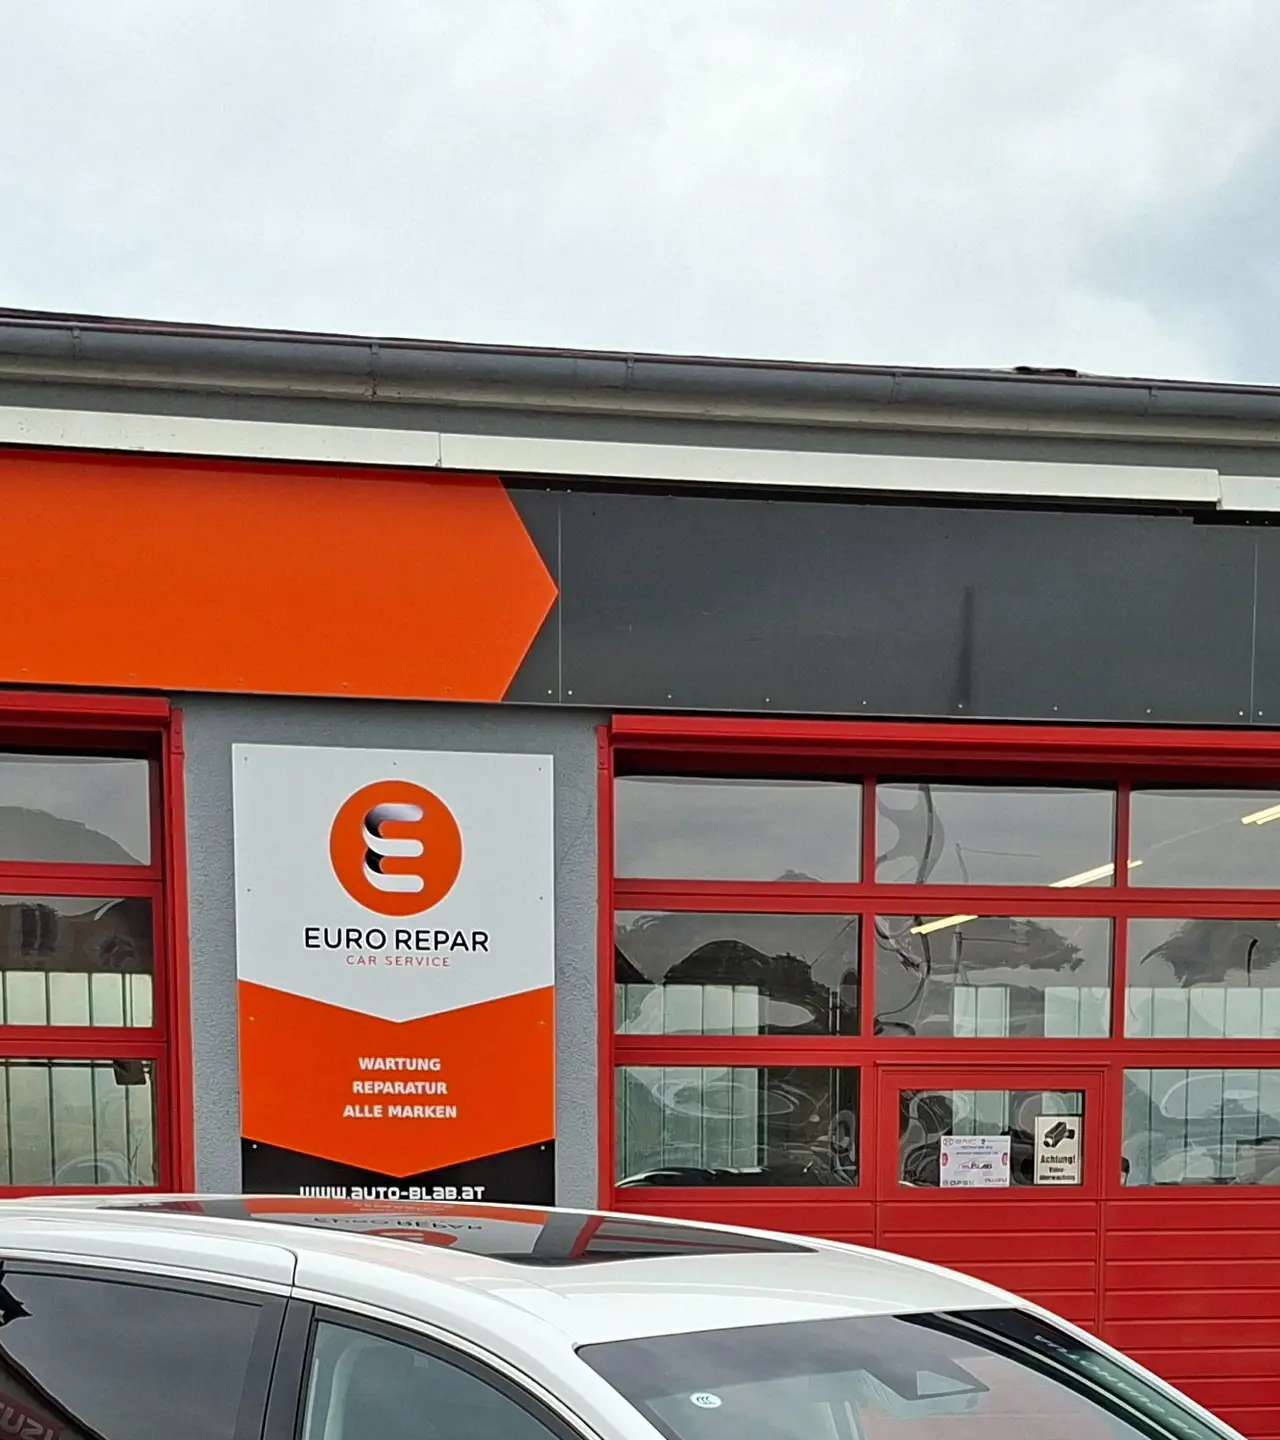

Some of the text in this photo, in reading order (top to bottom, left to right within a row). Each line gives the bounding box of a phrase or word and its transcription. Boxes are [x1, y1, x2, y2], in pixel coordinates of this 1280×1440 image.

[304, 926, 490, 953] EURO REPAR
[345, 954, 451, 968] CAR SERVICE
[358, 1057, 441, 1072] WARTUNG
[352, 1080, 448, 1095] REPARATUR
[343, 1104, 457, 1119] ALLE MARKEN
